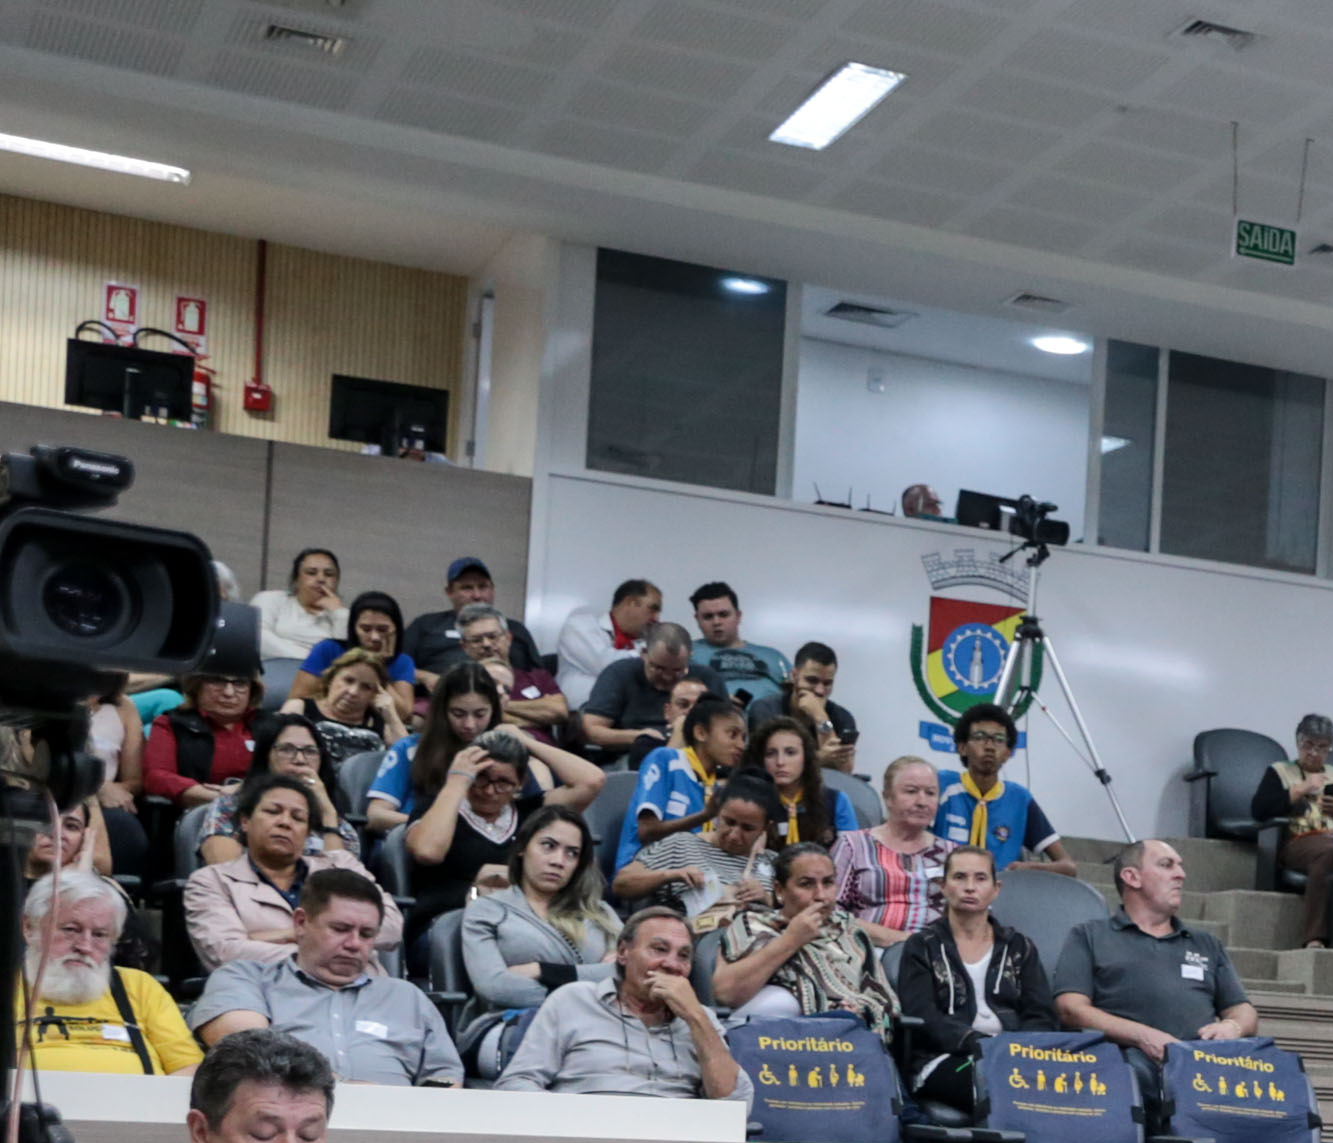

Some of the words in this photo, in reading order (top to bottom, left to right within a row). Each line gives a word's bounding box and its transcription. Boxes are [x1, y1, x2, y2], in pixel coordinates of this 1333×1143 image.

[758, 1036, 854, 1052] Prioritário
[1009, 1043, 1097, 1064] Prioritário
[1193, 1050, 1275, 1073] Prioritário
